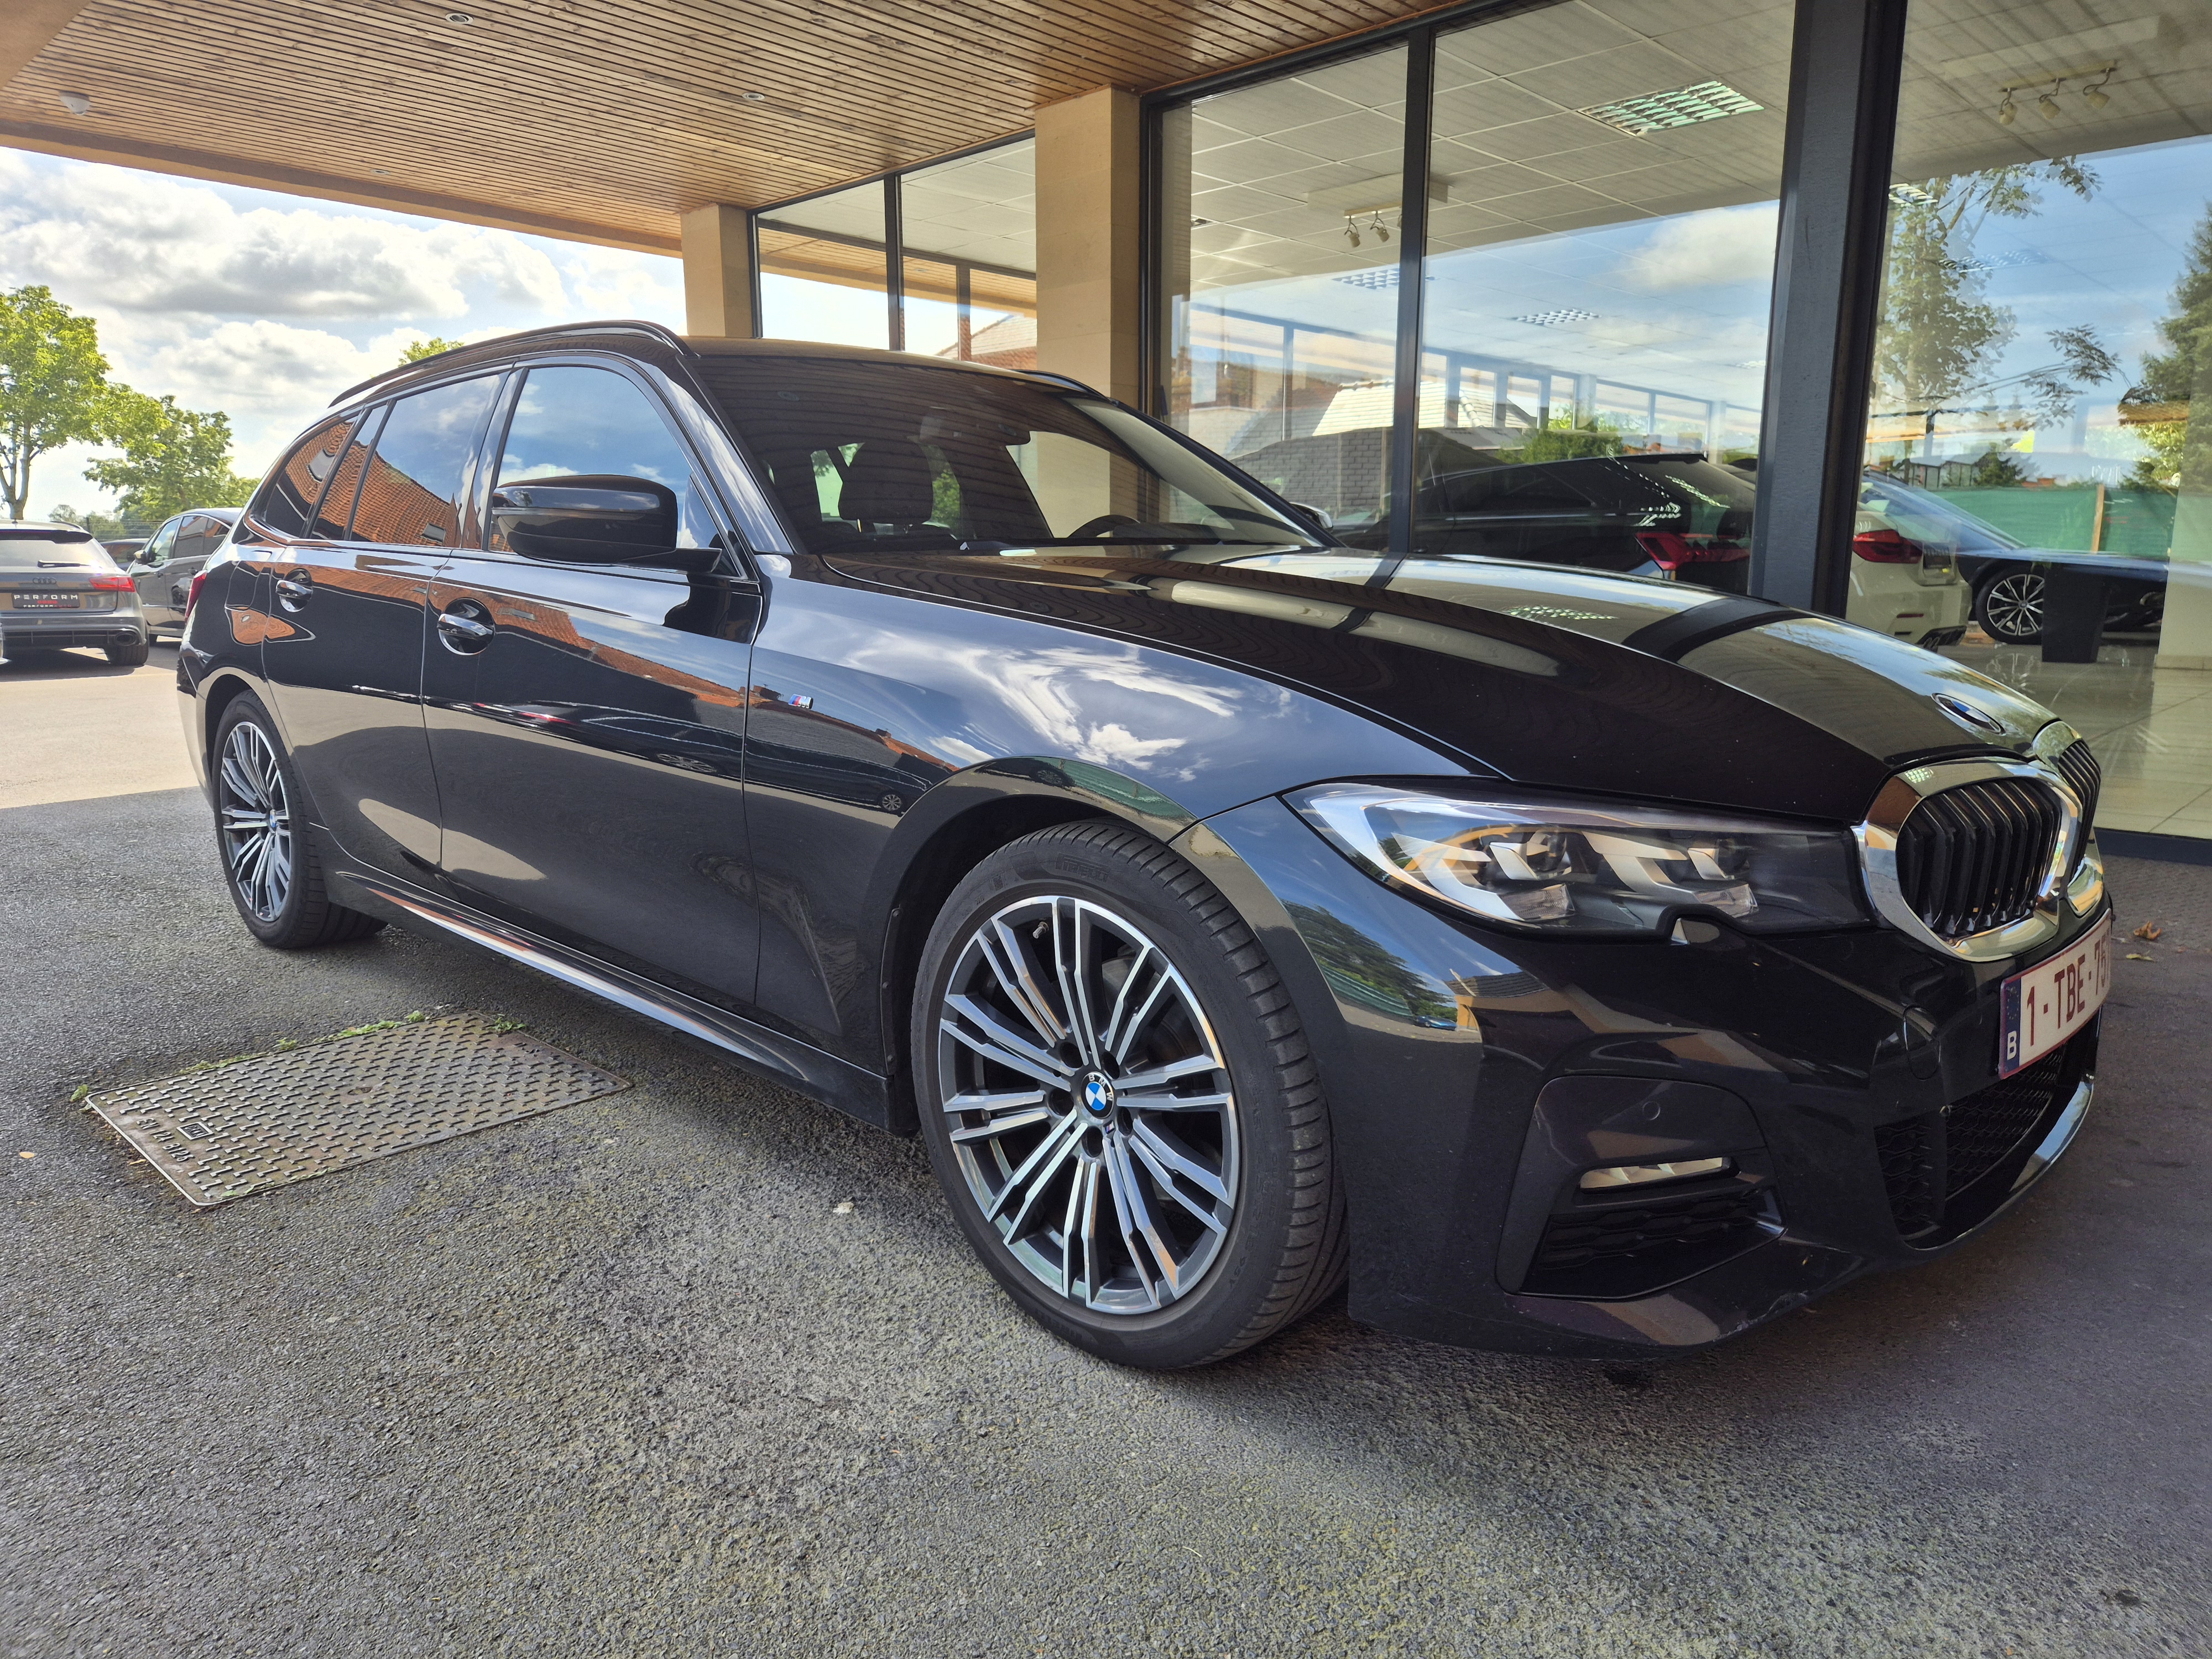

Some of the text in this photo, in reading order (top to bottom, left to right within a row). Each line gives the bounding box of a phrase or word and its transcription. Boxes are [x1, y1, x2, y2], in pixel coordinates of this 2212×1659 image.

[2007, 1030, 2017, 1061] B
[1088, 1074, 1113, 1101] BMW
[136, 1118, 160, 1130] EN
[149, 1130, 174, 1143] 124
[163, 1142, 195, 1162] B125
